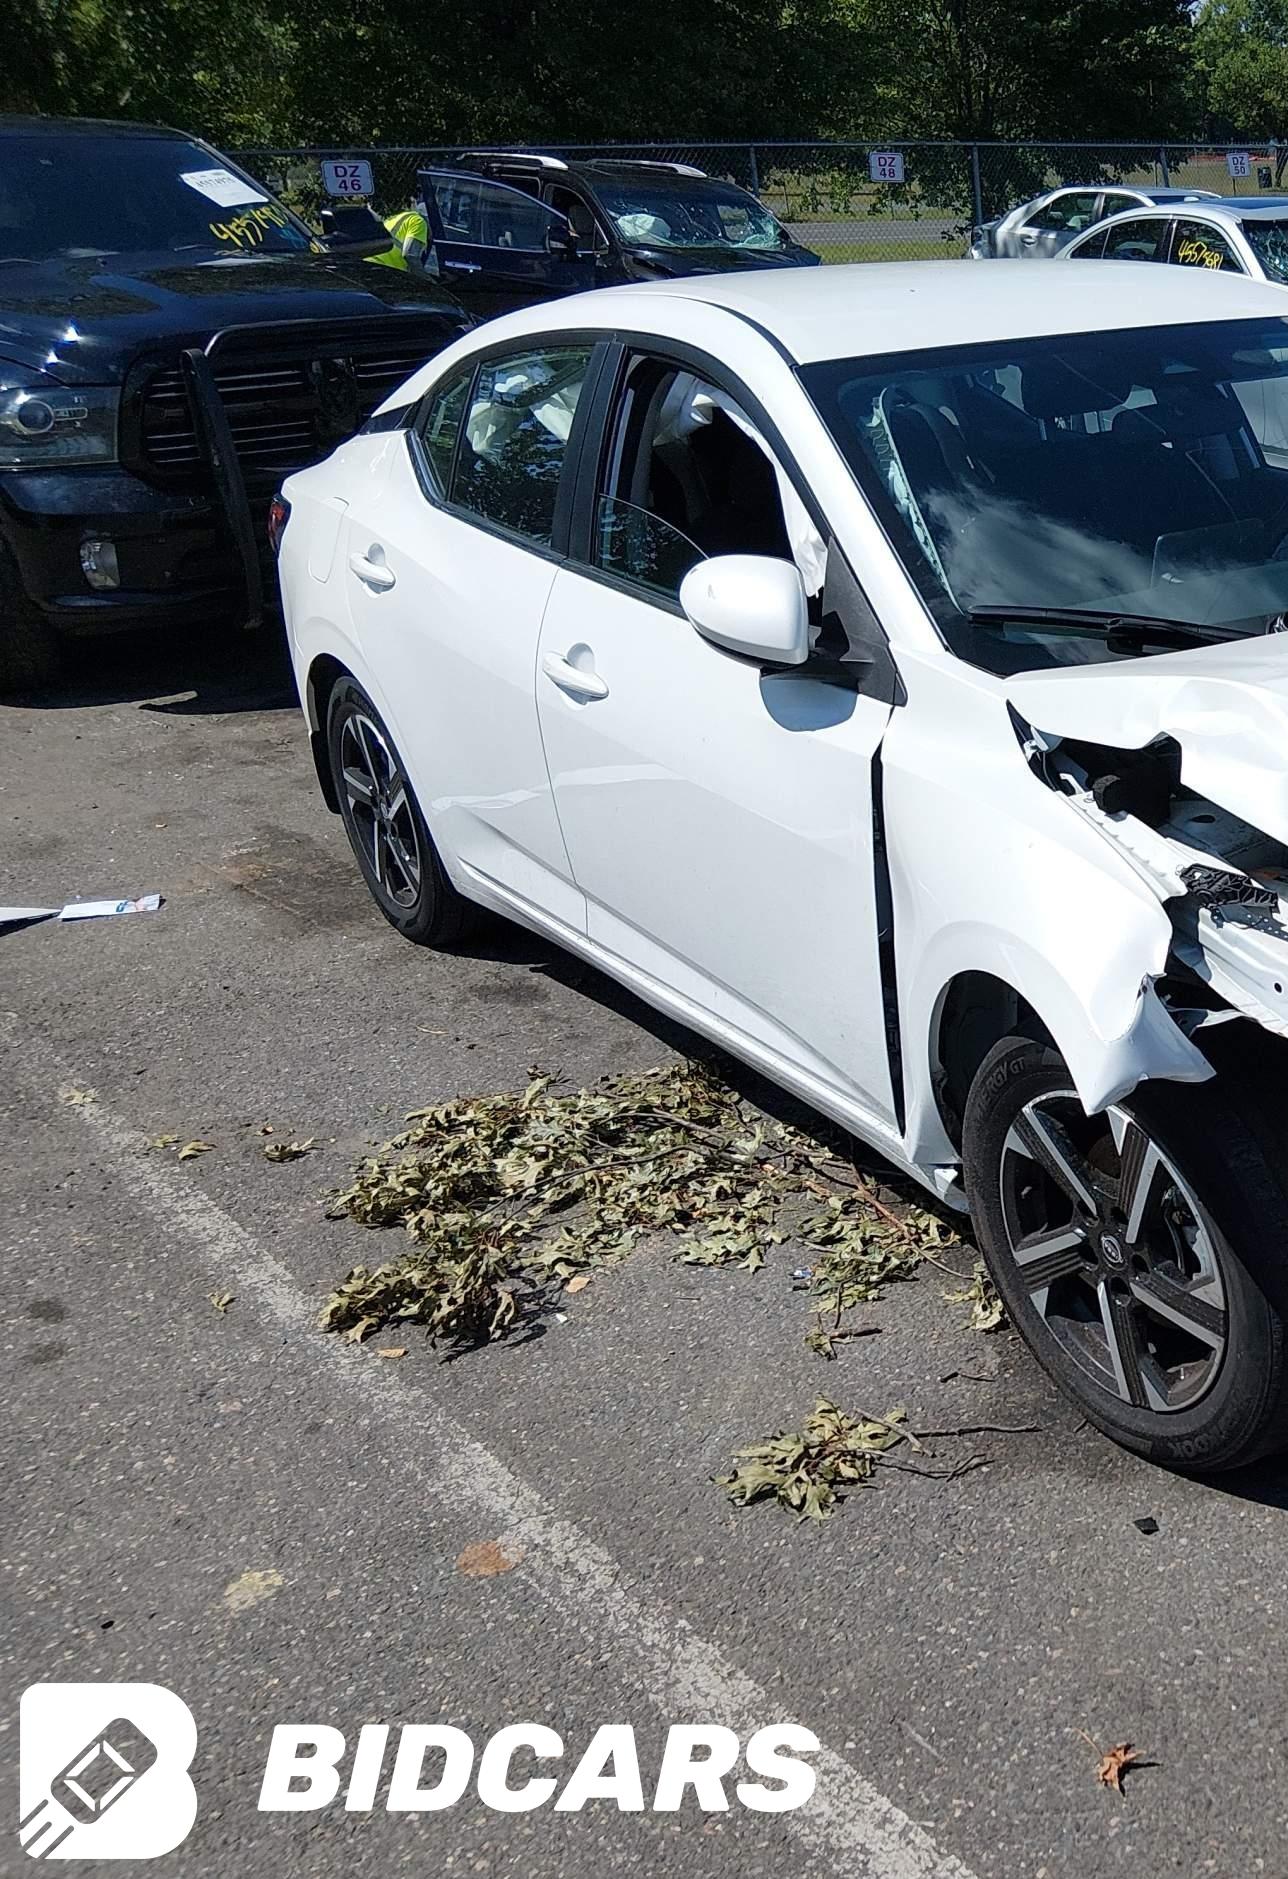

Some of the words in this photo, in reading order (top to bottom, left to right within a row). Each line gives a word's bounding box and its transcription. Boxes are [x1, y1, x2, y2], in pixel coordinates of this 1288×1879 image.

[877, 157, 896, 167] DZ
[1232, 156, 1245, 165] DZ
[333, 165, 361, 178] DZ
[880, 168, 896, 178] 48
[1234, 166, 1246, 174] 50
[338, 179, 362, 192] 46
